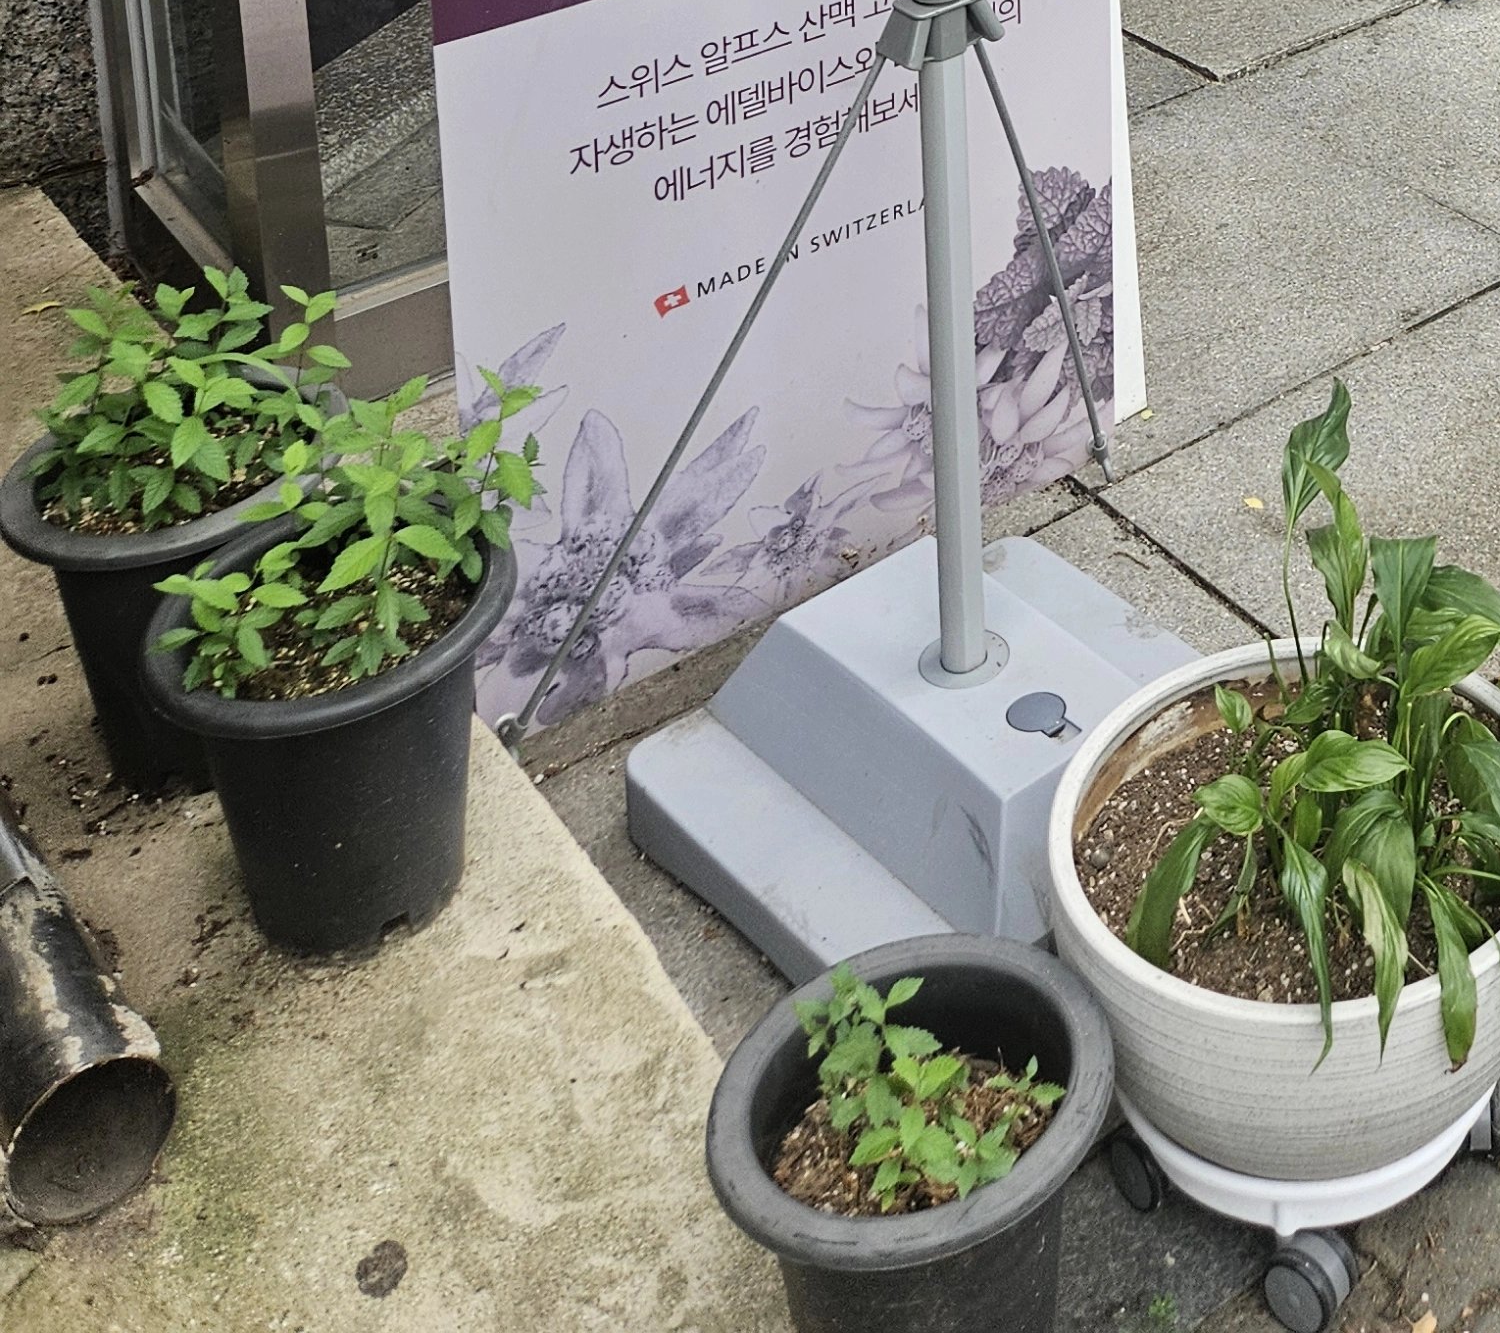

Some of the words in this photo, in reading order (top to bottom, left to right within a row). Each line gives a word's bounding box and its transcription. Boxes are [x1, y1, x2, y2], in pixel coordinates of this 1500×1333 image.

[596, 54, 694, 110] 스위스
[699, 21, 793, 75] 알프스
[568, 108, 700, 176] 자생하는
[653, 131, 778, 204] 에너지를
[783, 82, 921, 161] 경험해보세
[695, 255, 767, 299] MADE
[809, 194, 926, 255] SWITZERLA
